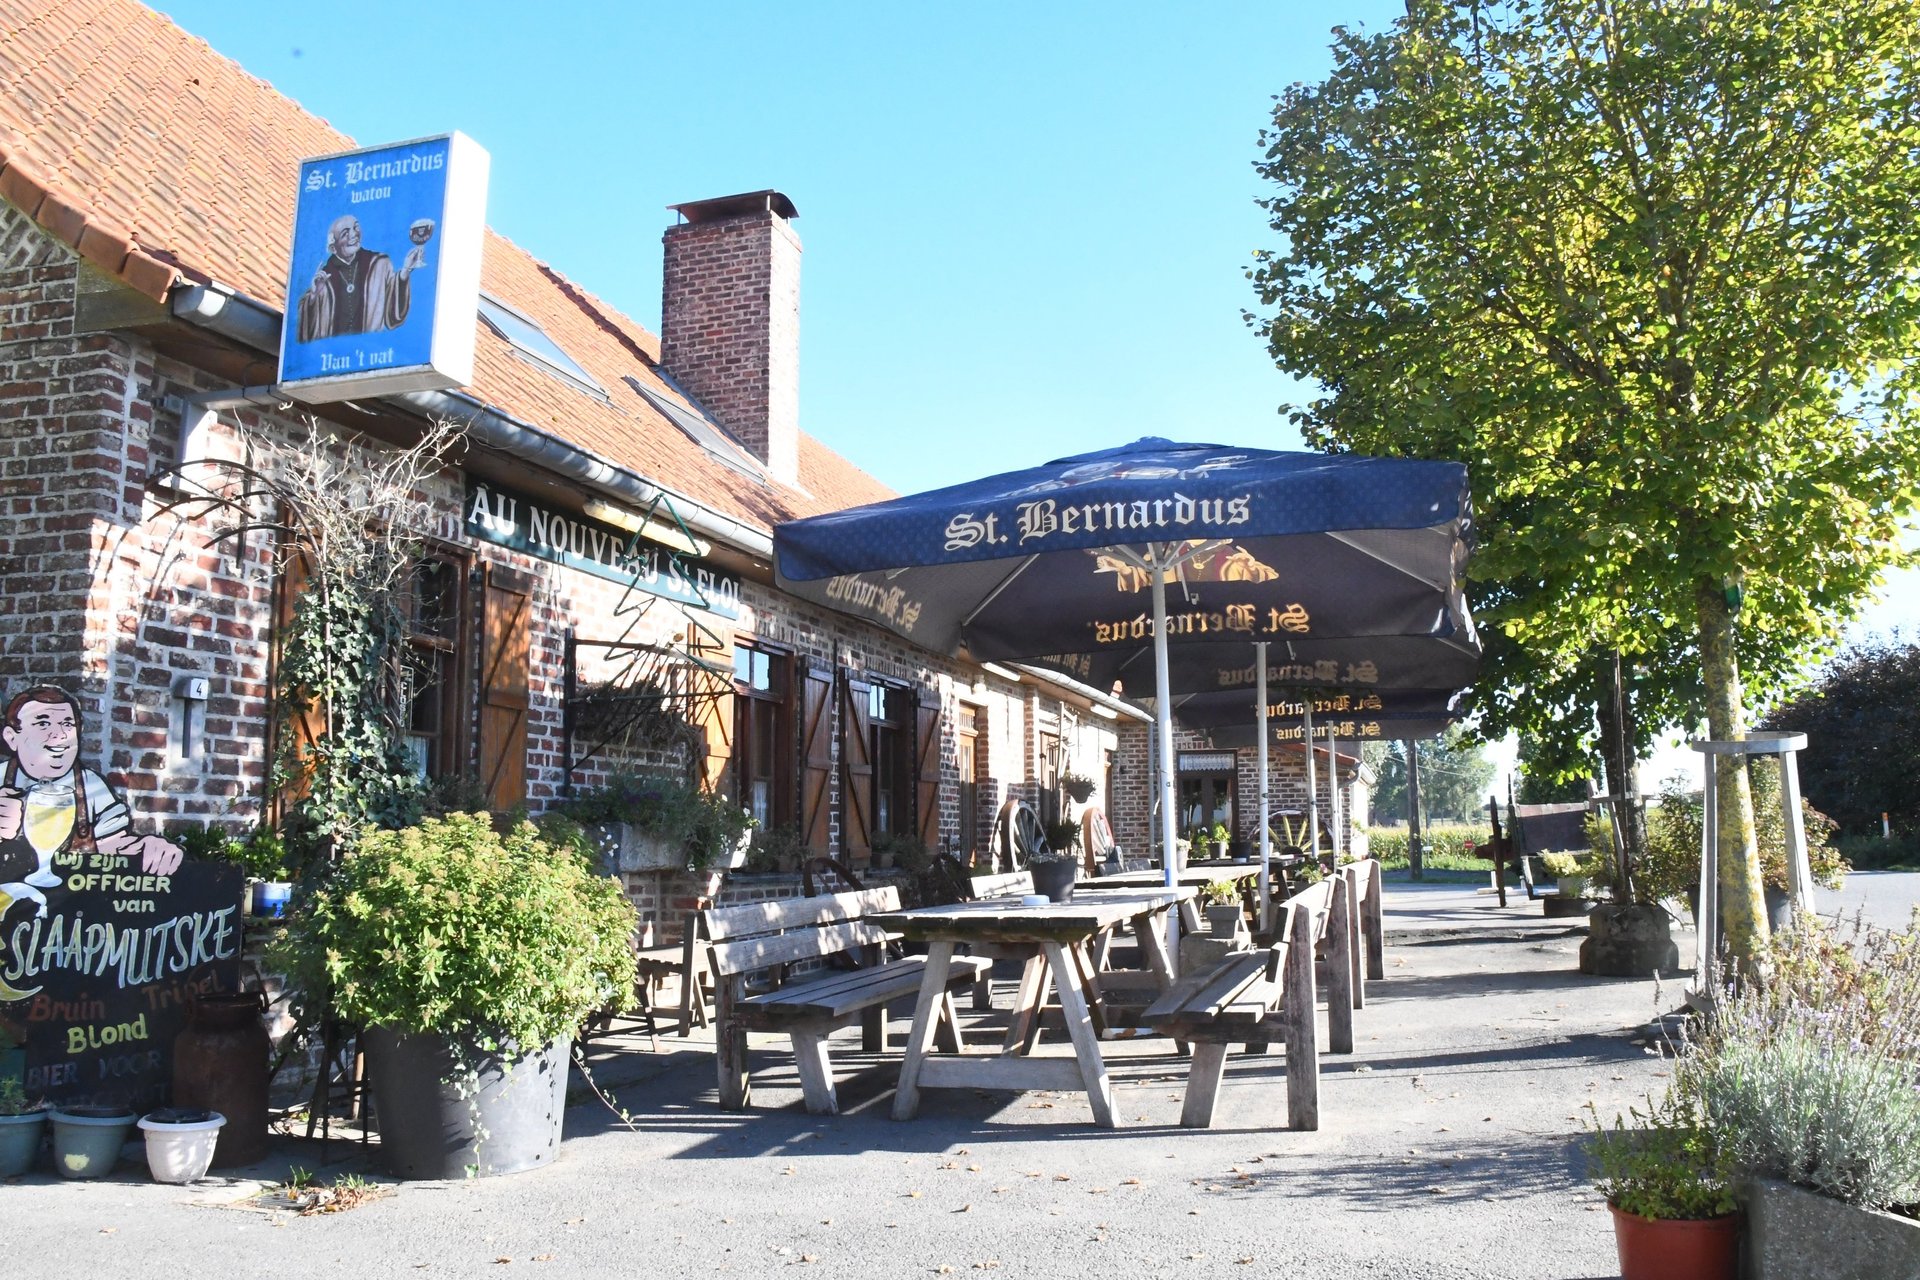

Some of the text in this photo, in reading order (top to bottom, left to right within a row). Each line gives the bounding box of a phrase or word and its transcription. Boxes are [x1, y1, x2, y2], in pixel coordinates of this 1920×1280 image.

[305, 153, 444, 192] St. Bernardus
[320, 353, 350, 372] Van
[369, 347, 394, 365] vat
[944, 492, 1251, 551] St. Bernardus
[468, 486, 516, 536] AU
[529, 505, 659, 584] NOUVEAU
[696, 567, 740, 611] ELOI
[196, 682, 202, 696] 4
[54, 851, 129, 872] wij zijn
[67, 874, 171, 893] OFFICIER
[113, 898, 156, 913] van
[28, 992, 105, 1021] Bruin
[26, 1060, 78, 1090] BIER
